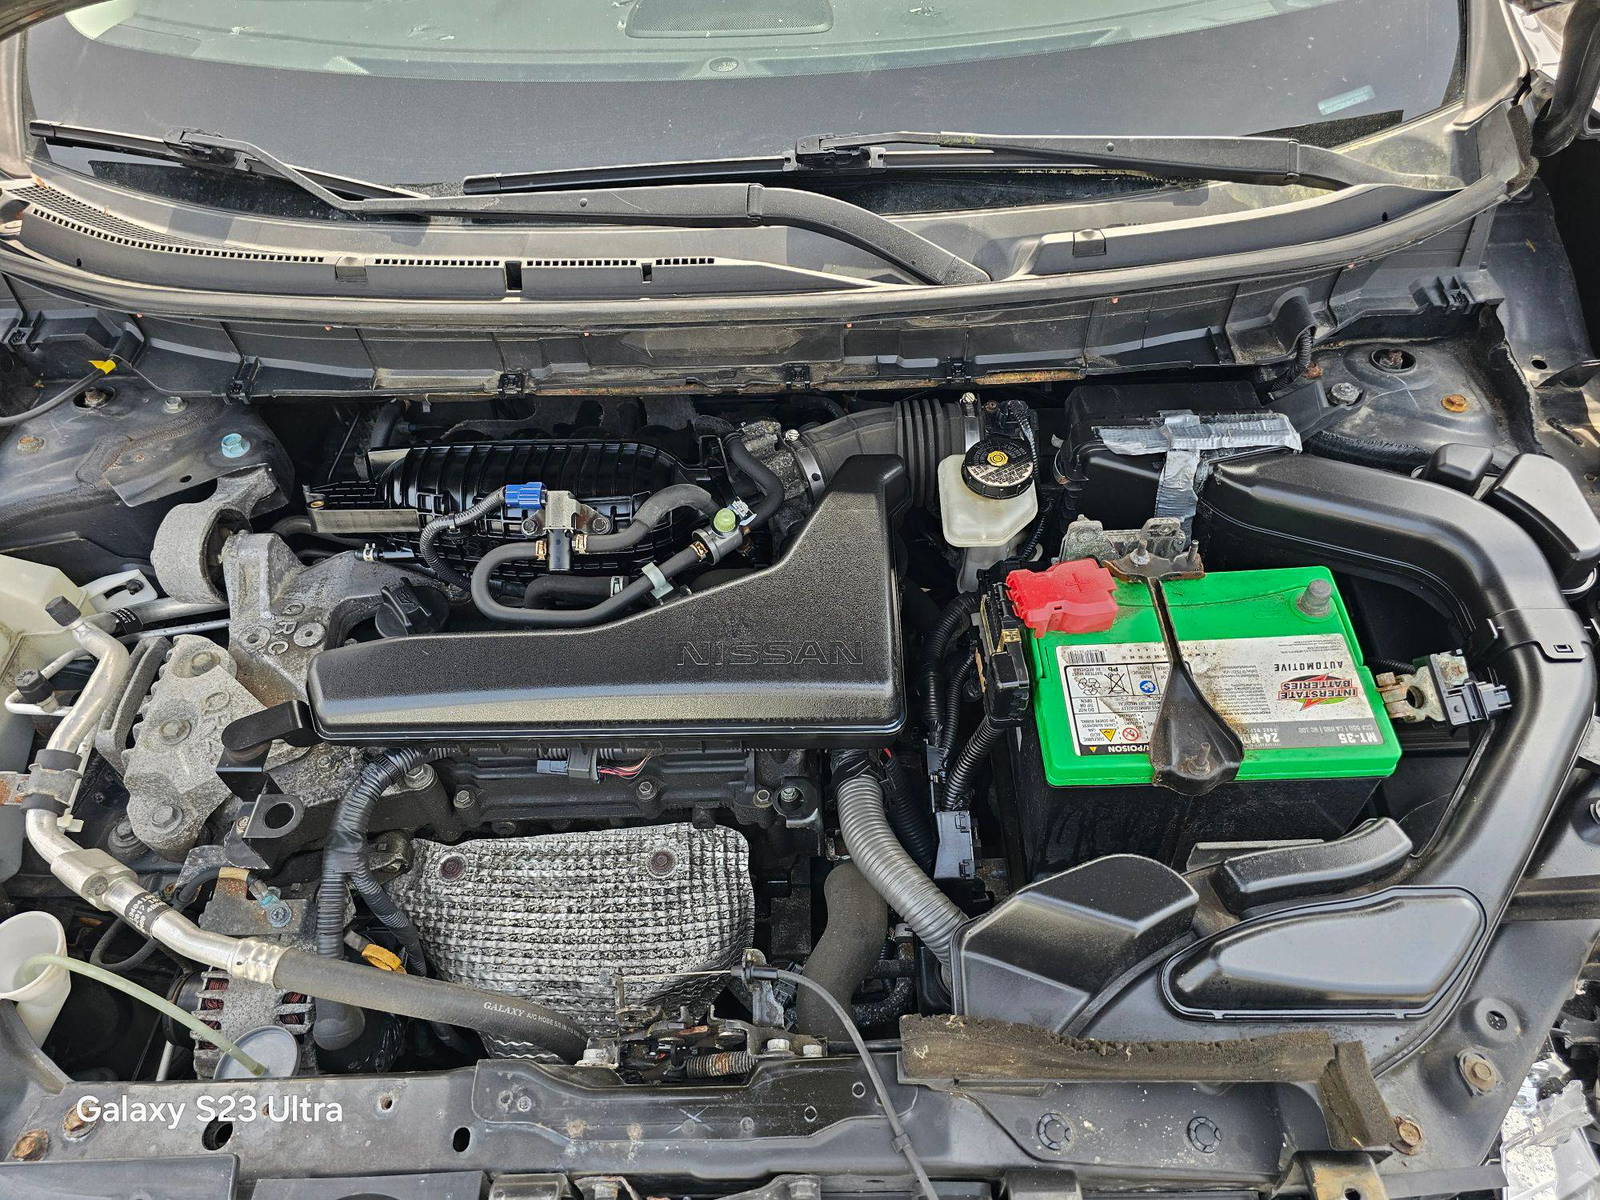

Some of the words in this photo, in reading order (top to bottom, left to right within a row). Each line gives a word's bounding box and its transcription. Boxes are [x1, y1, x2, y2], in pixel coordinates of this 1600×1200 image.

[677, 640, 865, 666] NISSAN
[1274, 660, 1344, 672] AUTOMOTIVE
[1283, 680, 1351, 691] BATTERIES
[1280, 689, 1356, 700] INTERSTATE
[1240, 732, 1280, 744] 24-MO
[1338, 732, 1378, 744] MT-35
[483, 1001, 525, 1017] GALAXY
